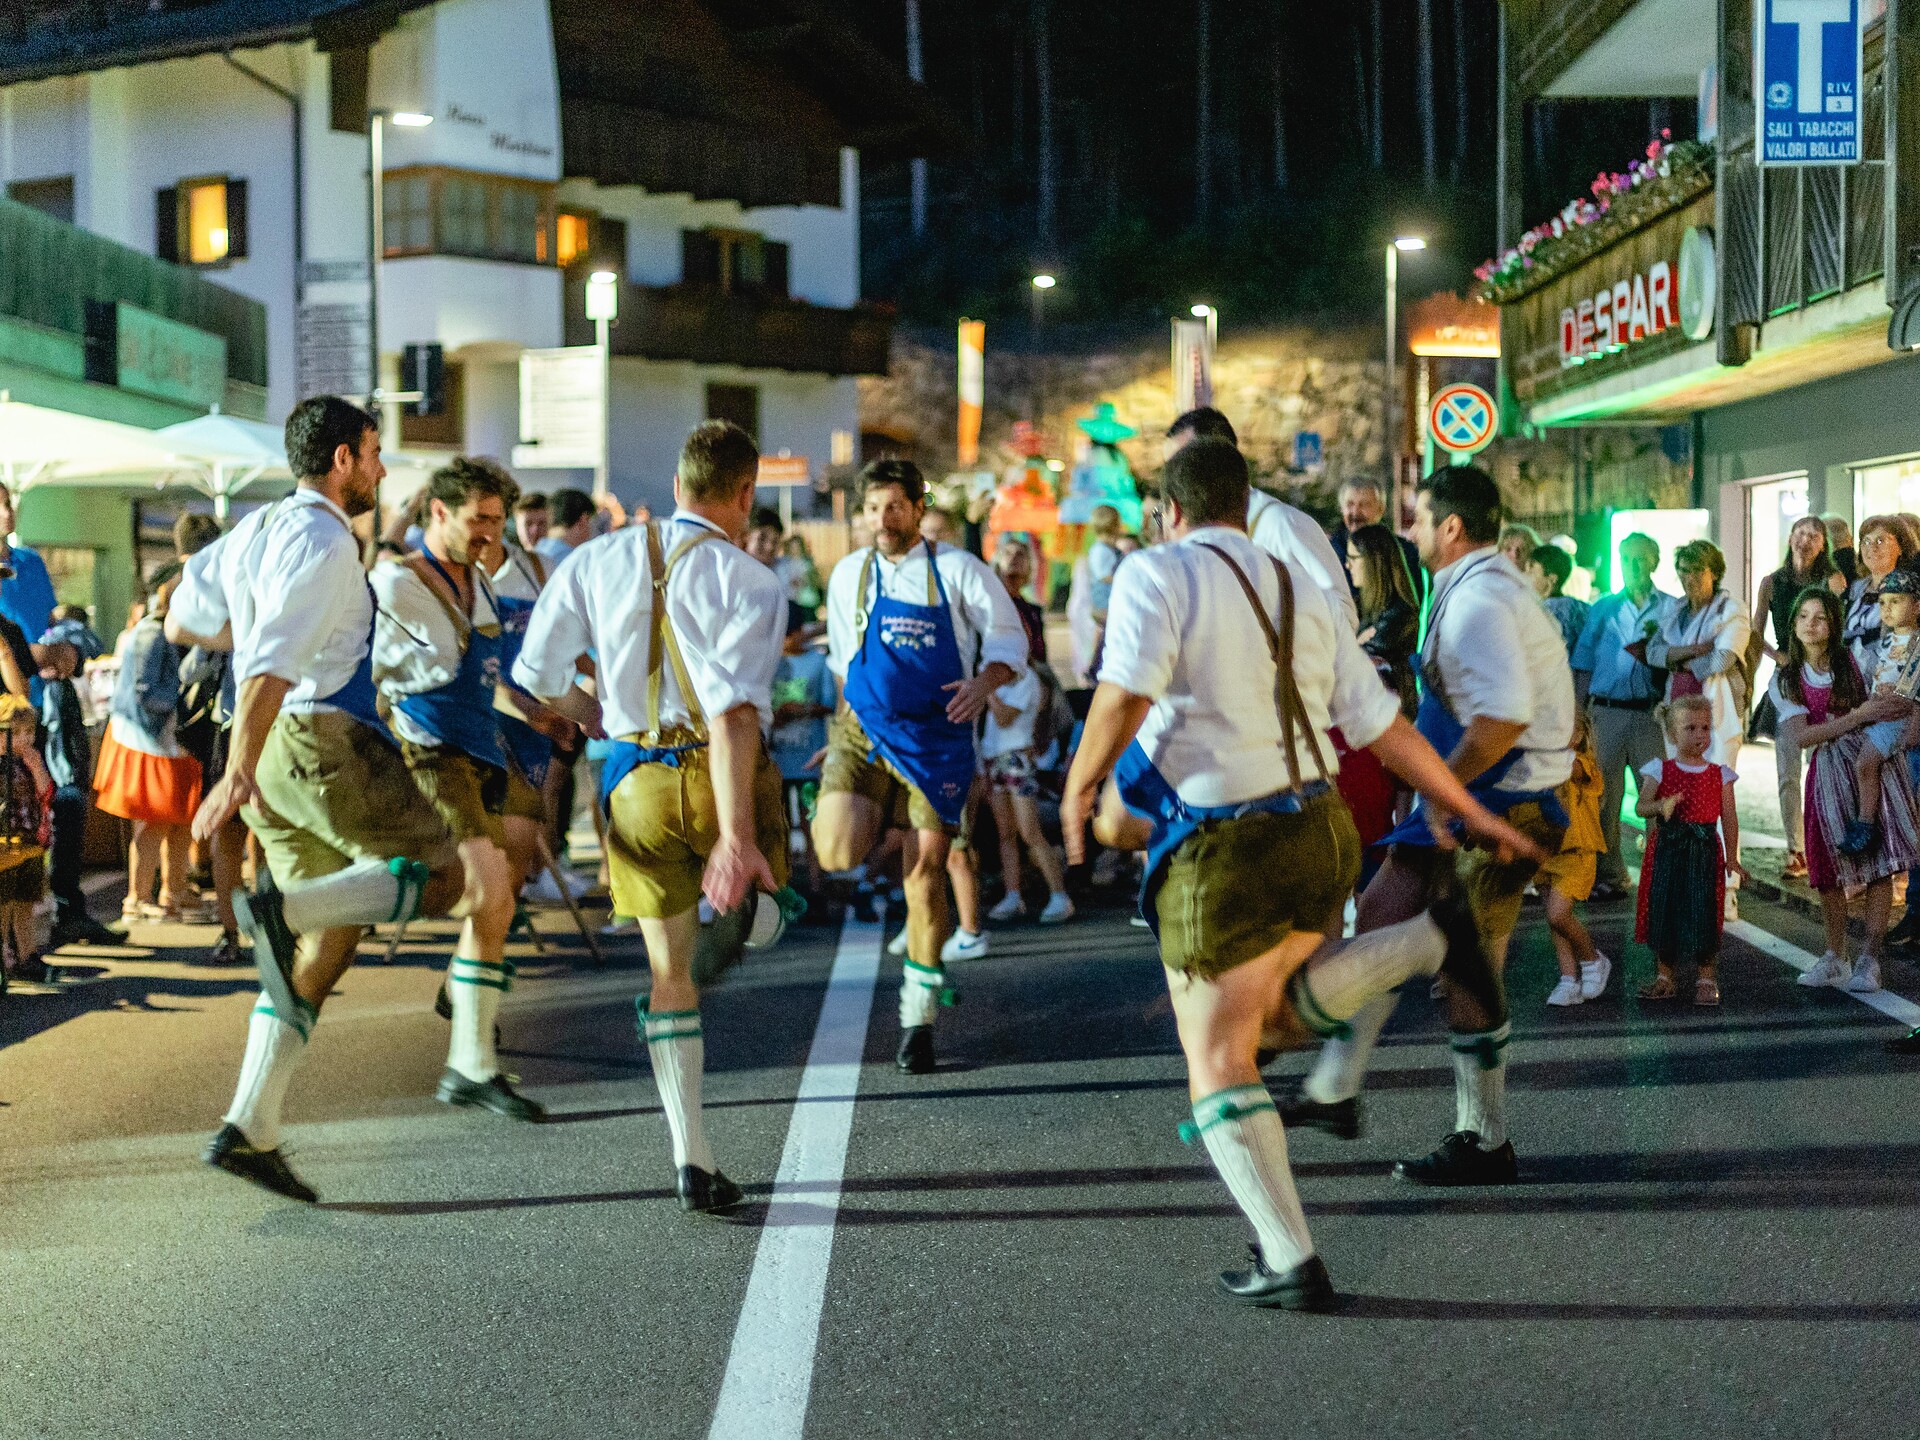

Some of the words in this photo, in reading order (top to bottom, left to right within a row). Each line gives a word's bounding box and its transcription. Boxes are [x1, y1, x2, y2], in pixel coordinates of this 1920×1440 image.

[1772, 0, 1850, 113] T
[1827, 82, 1853, 93] RIV.
[1767, 122, 1792, 137] SALI
[1798, 121, 1854, 137] TABACCHI
[1766, 142, 1806, 158] VALORI
[1810, 142, 1855, 158] BOLLATI
[1559, 260, 1674, 369] DESPAR
